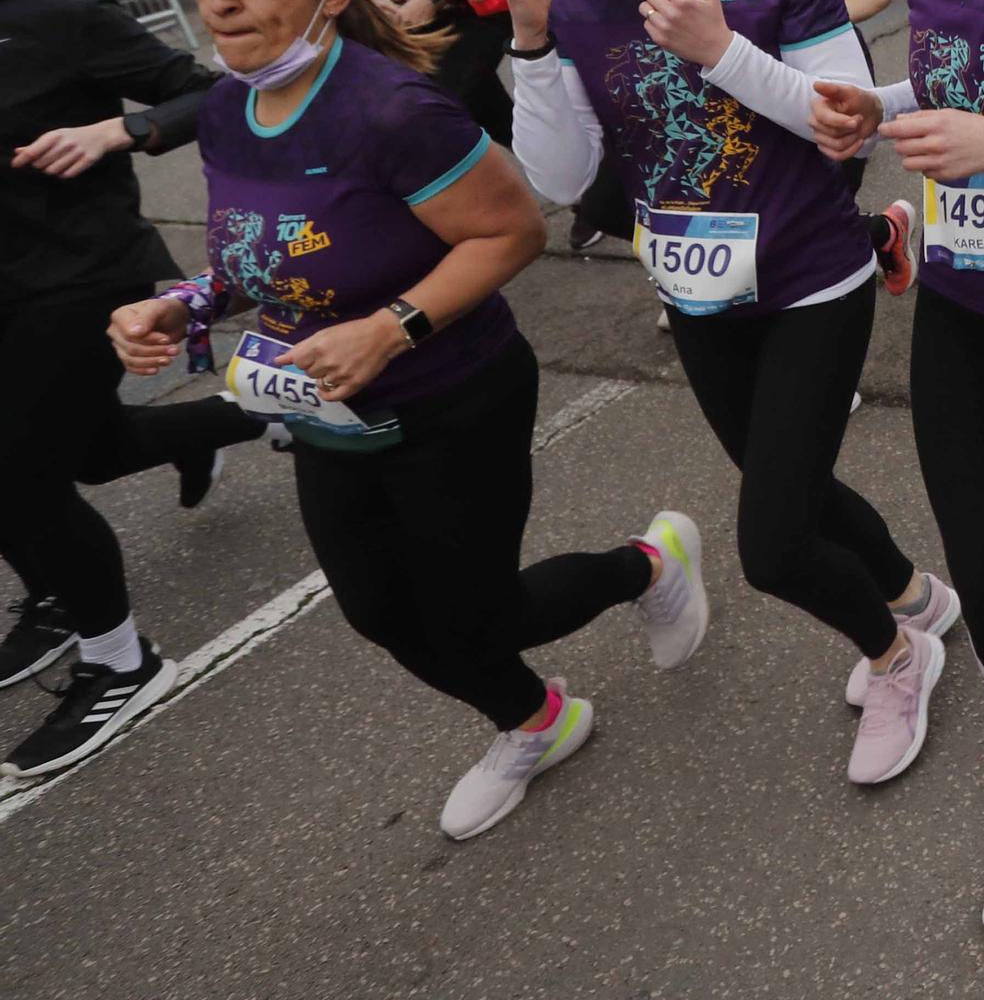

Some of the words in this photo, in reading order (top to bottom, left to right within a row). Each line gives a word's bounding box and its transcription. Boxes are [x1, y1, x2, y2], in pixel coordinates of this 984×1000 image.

[291, 234, 327, 255] FEM
[648, 238, 732, 278] 1500
[672, 283, 693, 295] Ana
[247, 368, 322, 408] 1455
